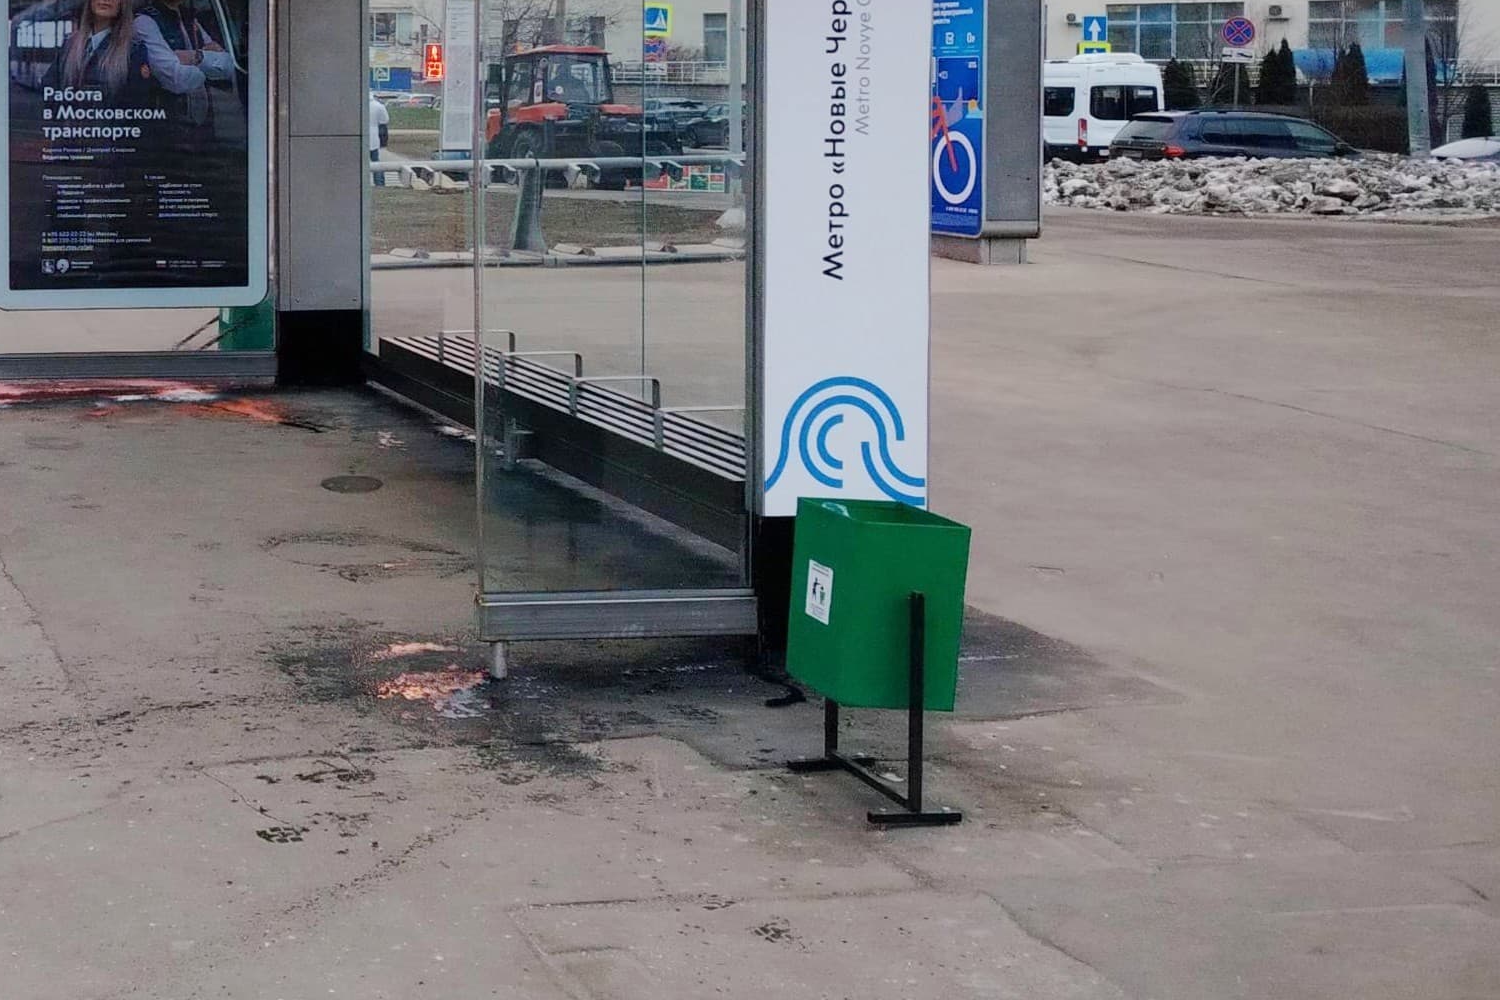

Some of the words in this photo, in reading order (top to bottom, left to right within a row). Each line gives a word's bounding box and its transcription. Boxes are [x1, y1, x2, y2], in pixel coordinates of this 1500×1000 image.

[855, 11, 875, 70] Novye
[43, 86, 102, 101] Работа
[43, 108, 52, 120] в
[56, 105, 167, 120] Московском
[824, 62, 846, 174] «Новые
[855, 76, 871, 136] Metro
[42, 126, 141, 141] транспорте
[822, 184, 850, 281] Метро
